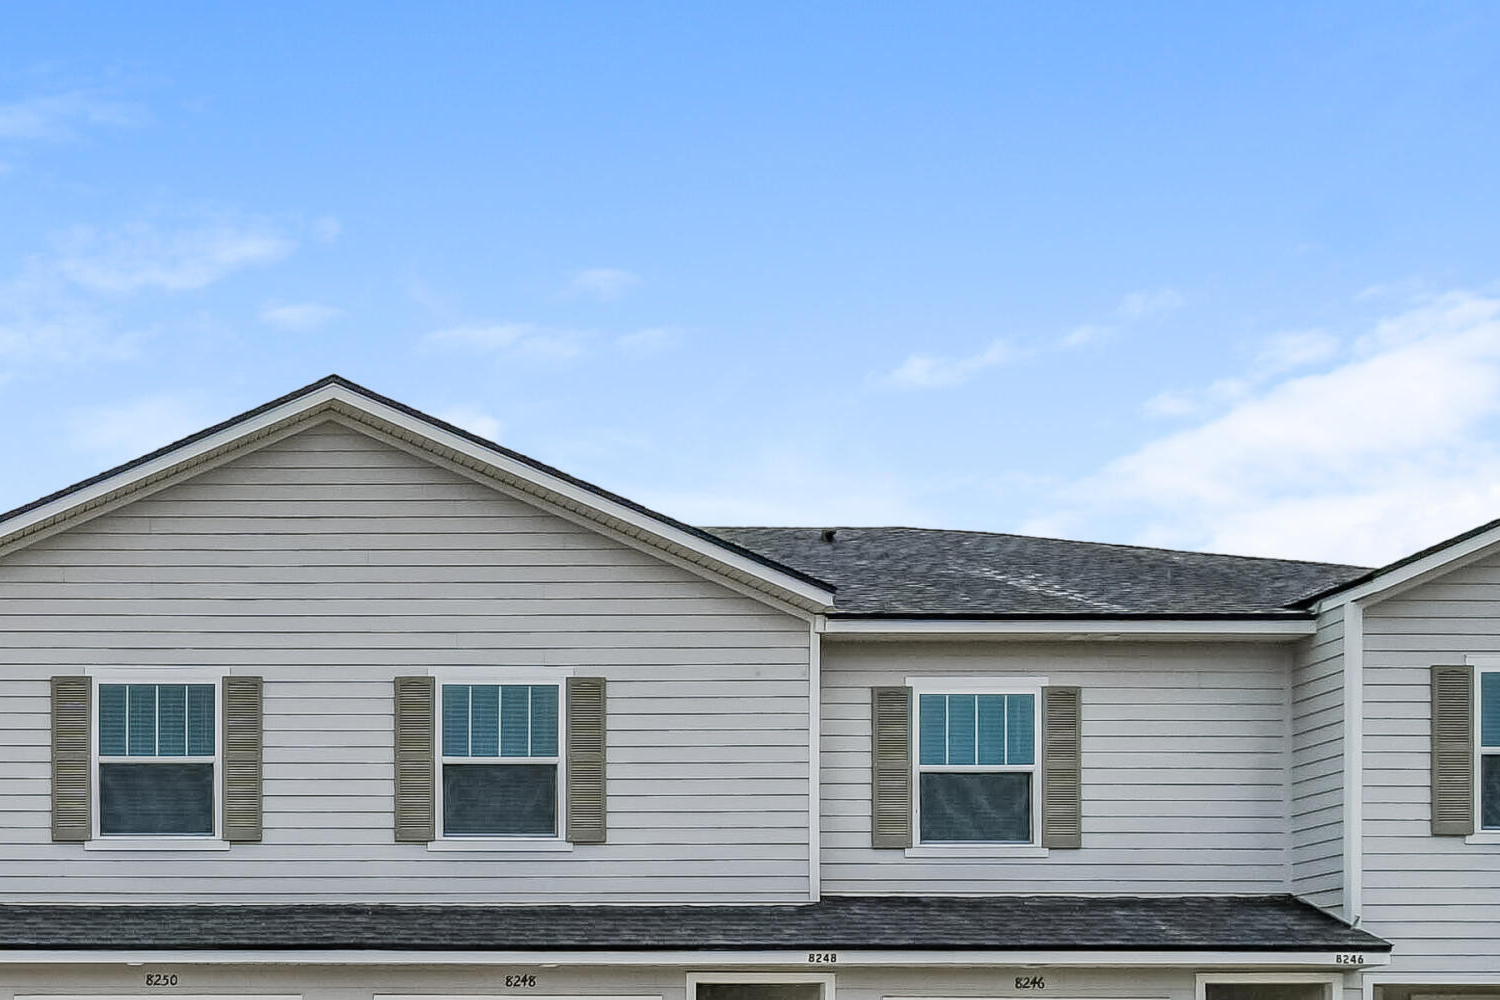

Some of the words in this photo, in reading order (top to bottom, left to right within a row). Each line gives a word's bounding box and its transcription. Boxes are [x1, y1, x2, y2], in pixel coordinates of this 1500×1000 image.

[808, 953, 836, 962] 8248
[1336, 954, 1364, 964] 8246
[146, 974, 178, 986] 8250
[505, 974, 537, 987] 8248
[1015, 976, 1045, 988] 8246
